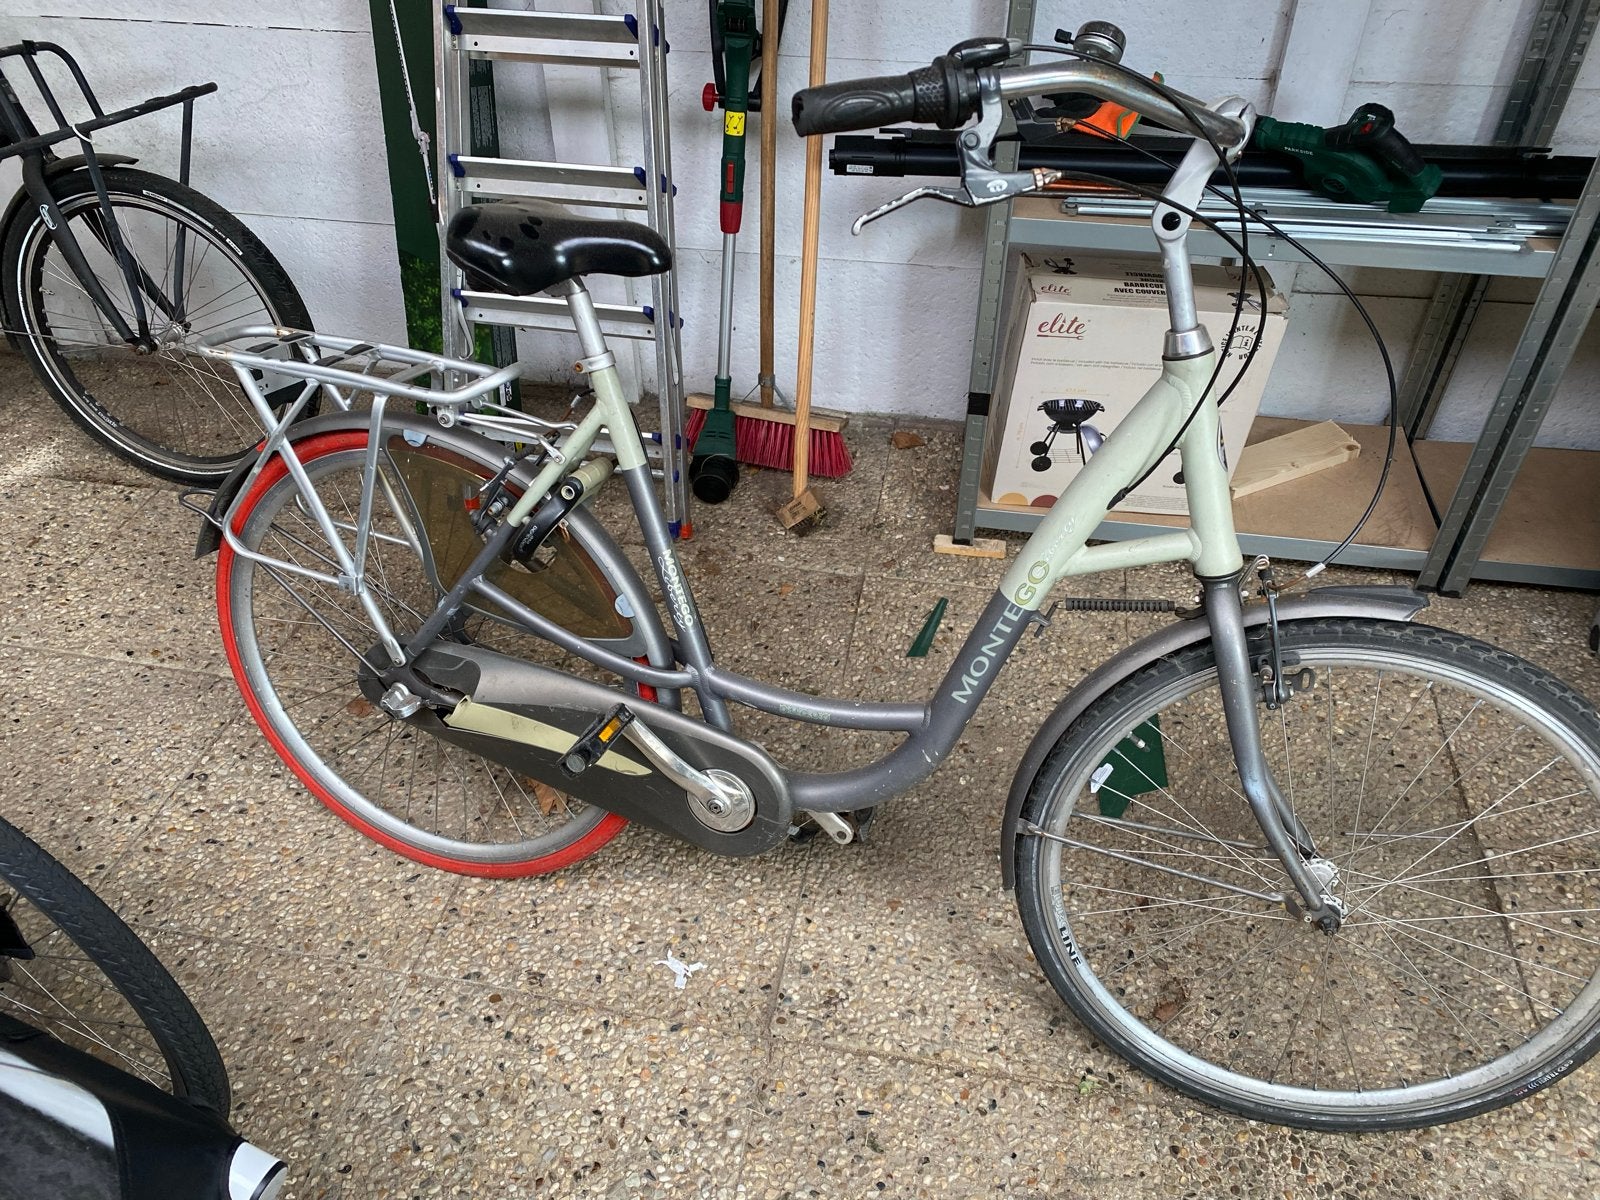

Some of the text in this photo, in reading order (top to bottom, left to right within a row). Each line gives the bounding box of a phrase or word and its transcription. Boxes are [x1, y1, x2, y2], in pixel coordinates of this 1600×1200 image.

[1284, 146, 1313, 156] PARKSIDE
[1123, 281, 1164, 289] BARBECUE
[1037, 312, 1087, 335] elite
[662, 549, 694, 627] MONTEGO
[951, 560, 1050, 704] MONTEGO
